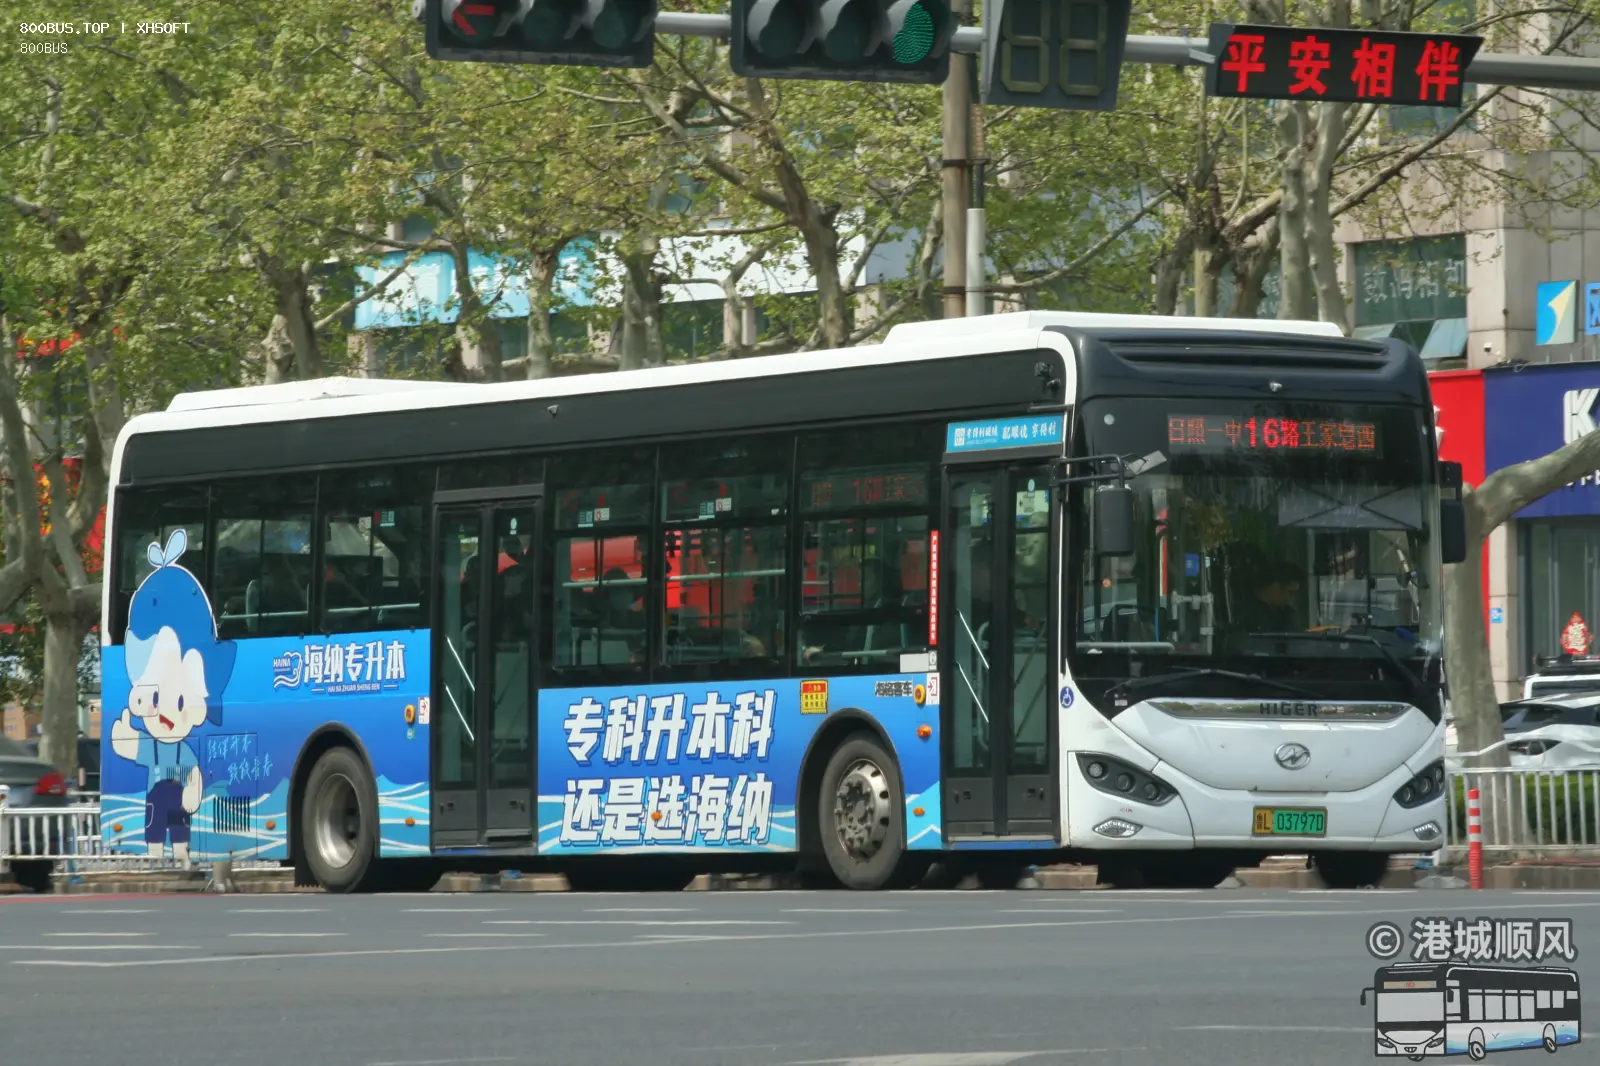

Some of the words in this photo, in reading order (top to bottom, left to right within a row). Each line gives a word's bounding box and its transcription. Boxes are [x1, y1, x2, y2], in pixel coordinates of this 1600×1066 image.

[1221, 33, 1461, 101] 平安相伴
[1168, 417, 1242, 445] 日照一中
[1244, 417, 1300, 448] 16路
[303, 640, 405, 684] 海纳专升本
[564, 689, 776, 764] 专科升本科
[1260, 702, 1319, 716] HIGER
[560, 773, 774, 845] 还是选海纳
